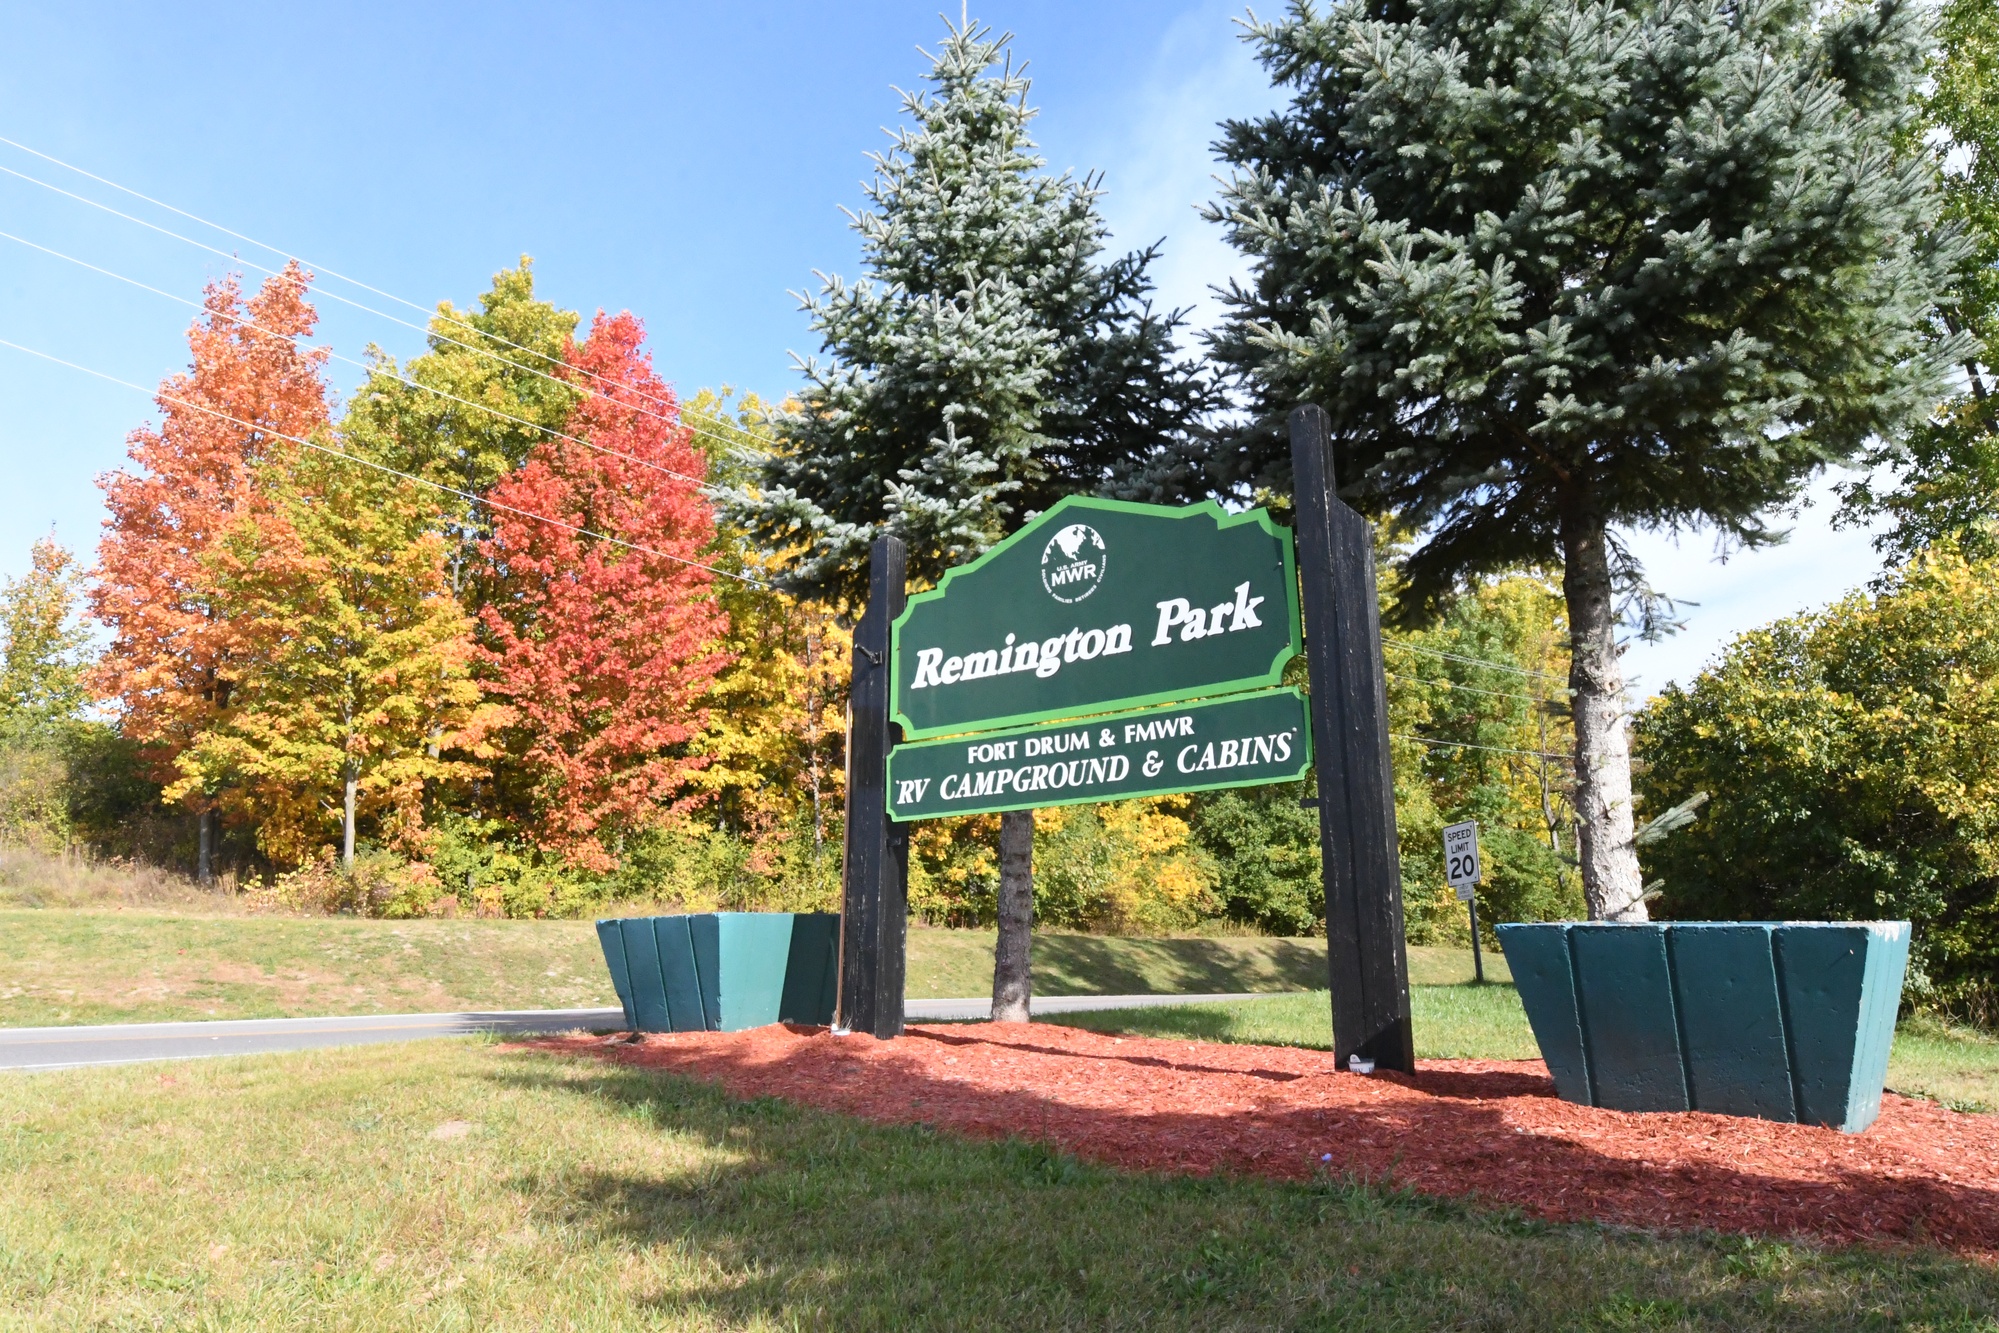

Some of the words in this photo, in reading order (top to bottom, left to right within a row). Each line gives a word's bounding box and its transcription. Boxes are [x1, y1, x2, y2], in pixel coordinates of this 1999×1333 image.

[1051, 563, 1097, 587] MWR
[1070, 559, 1088, 569] ARMY
[911, 623, 1133, 690] Remington
[1151, 581, 1266, 647] Park
[967, 740, 1018, 764] FORT
[1025, 731, 1091, 757] DRUM
[1098, 728, 1116, 748] &
[1125, 716, 1195, 744] FMWR
[896, 778, 931, 805] RV
[940, 754, 1130, 801] CAMPGROUND
[1142, 750, 1164, 778] &
[1177, 732, 1293, 774] CABINS
[1447, 828, 1472, 842] SPEED
[1450, 842, 1470, 855] LIMIT
[1449, 854, 1475, 880] 20
